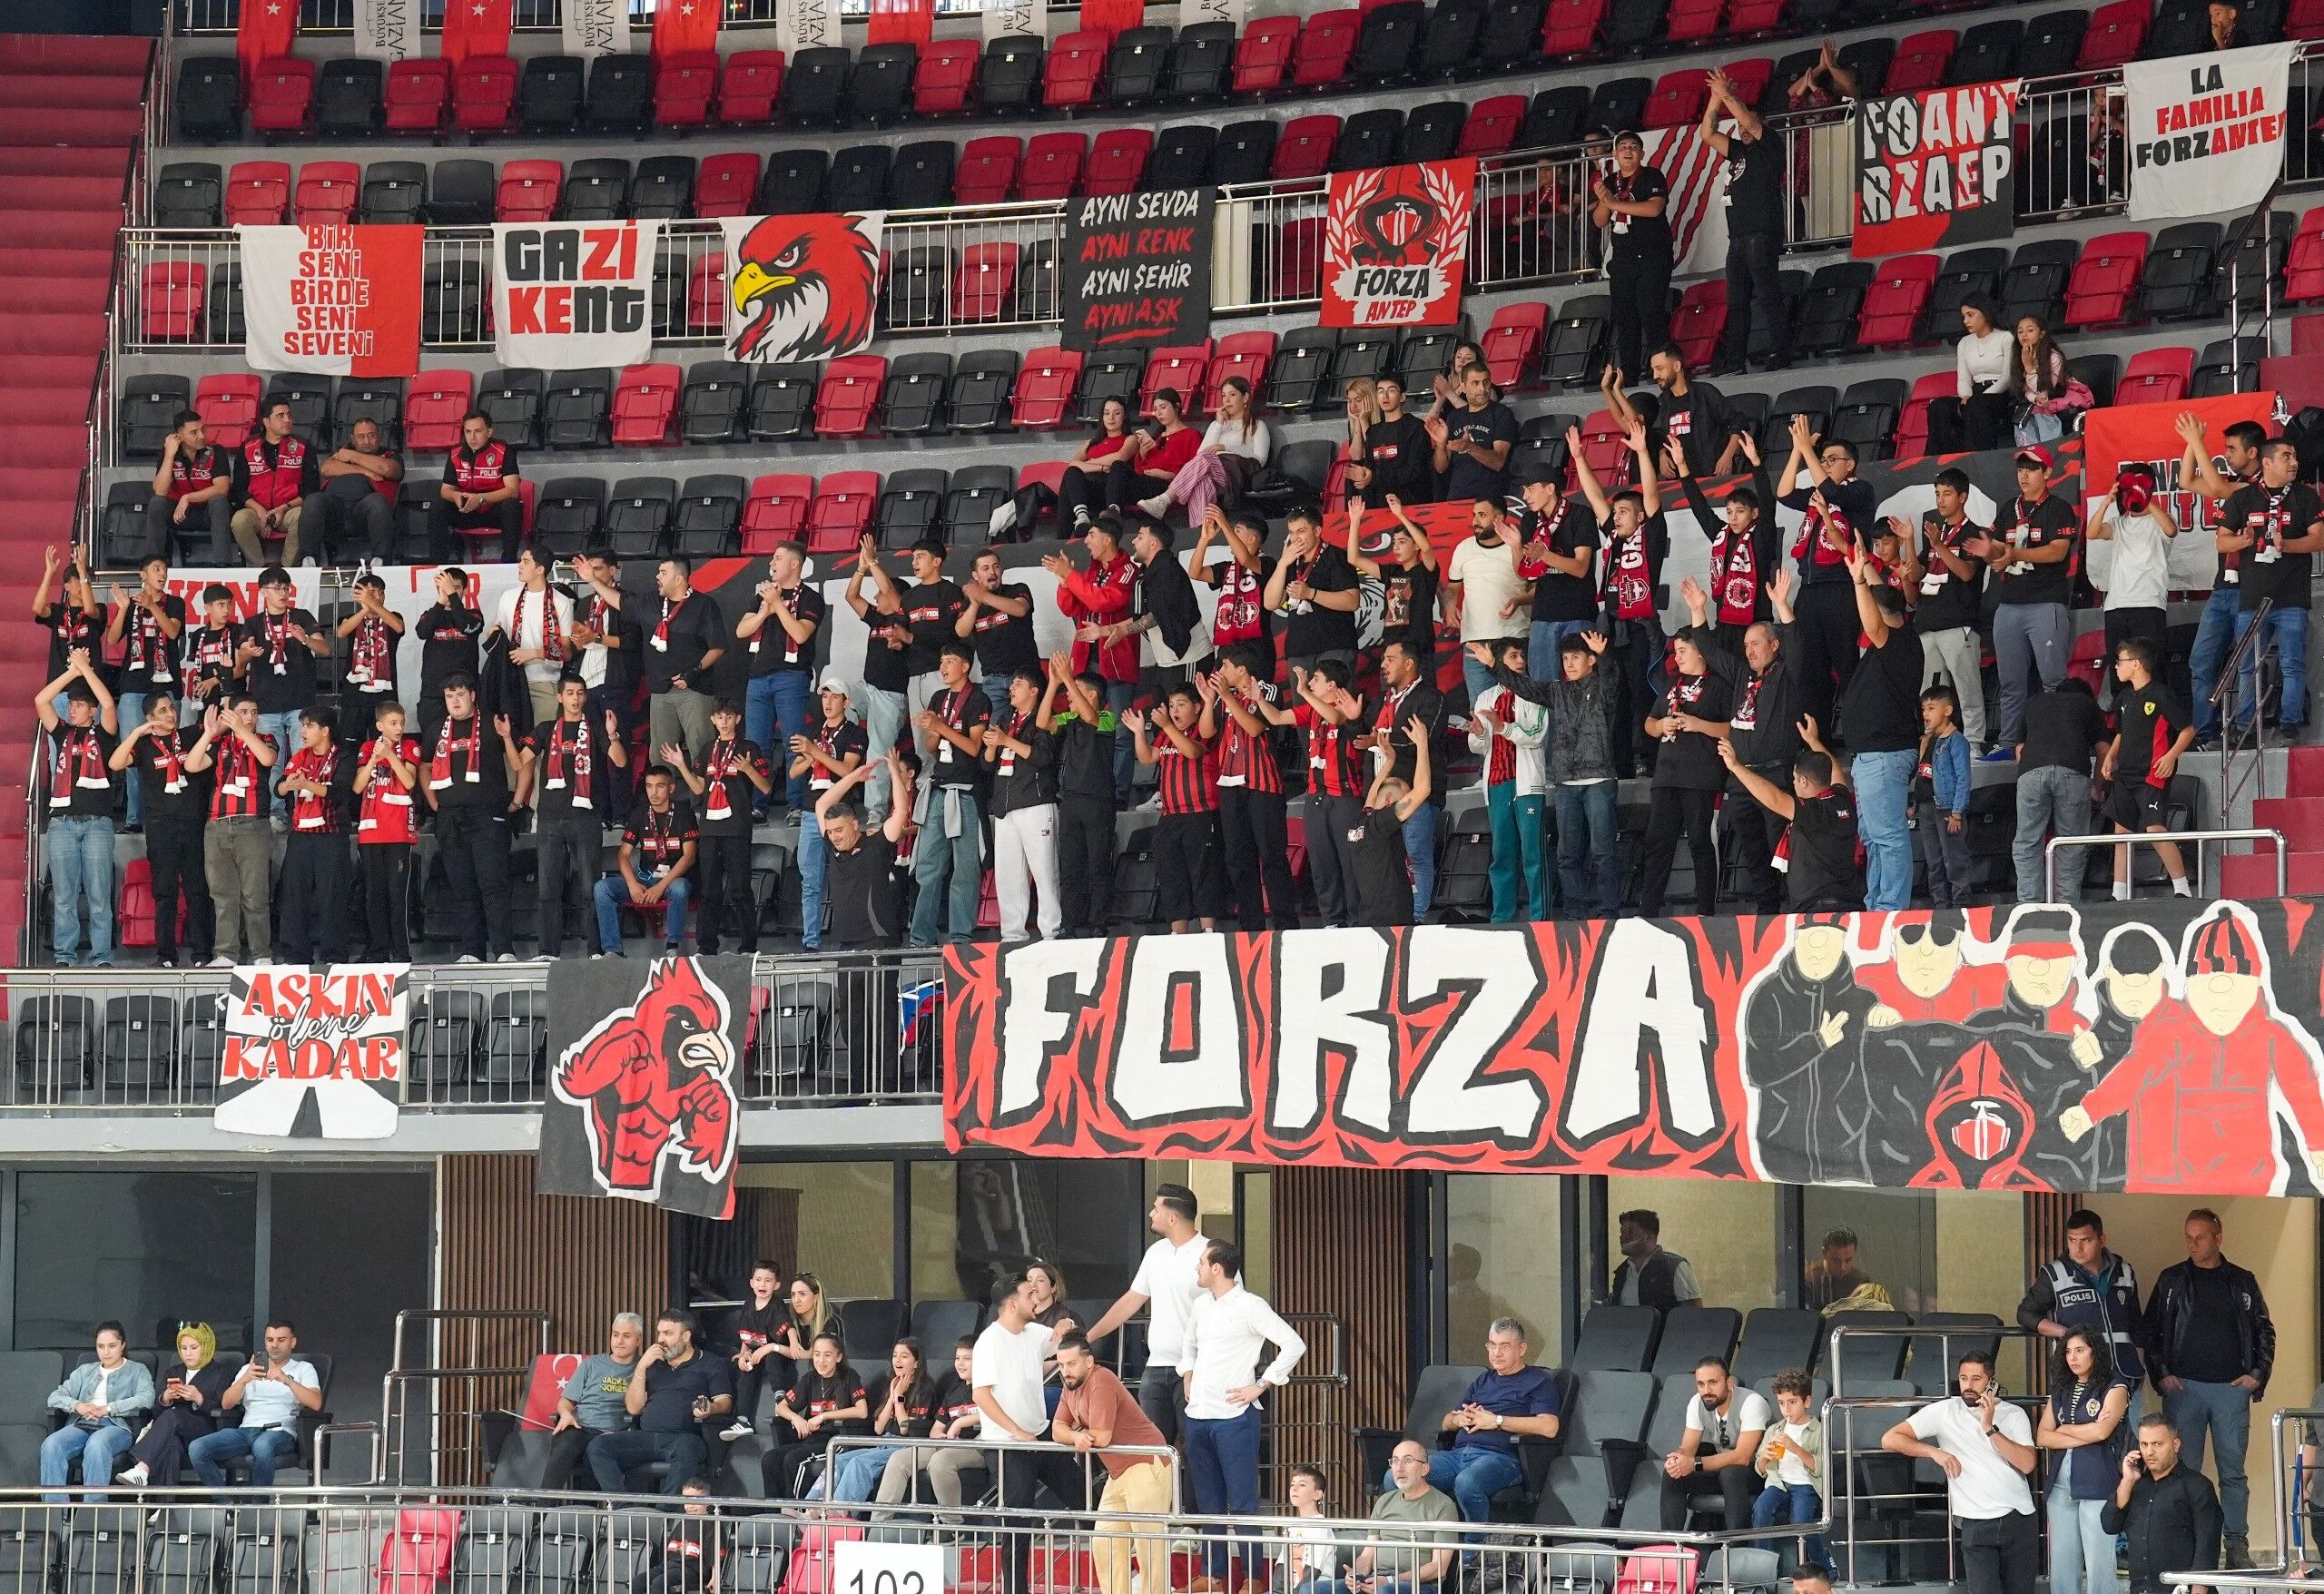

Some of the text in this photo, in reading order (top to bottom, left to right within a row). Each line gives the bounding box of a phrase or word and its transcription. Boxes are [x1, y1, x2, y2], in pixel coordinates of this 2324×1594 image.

[2191, 64, 2224, 94] LA
[1864, 84, 2021, 159] FOANT
[2156, 86, 2264, 134] FAMILIA
[1863, 145, 2011, 223] RZAEP
[1079, 189, 1199, 227] AYNI SEVDA
[505, 219, 638, 281] GAZİ
[1080, 227, 1196, 262] AYNI RENK
[1081, 259, 1192, 299] AYNI ŞEHİR
[1354, 268, 1430, 298] FORZA
[1084, 297, 1182, 330] AYNI AŞK
[1364, 300, 1417, 322] ANTEP
[270, 994, 375, 1050] ölene
[1002, 918, 1716, 1141] FORZA
[222, 1038, 400, 1080] KADAR
